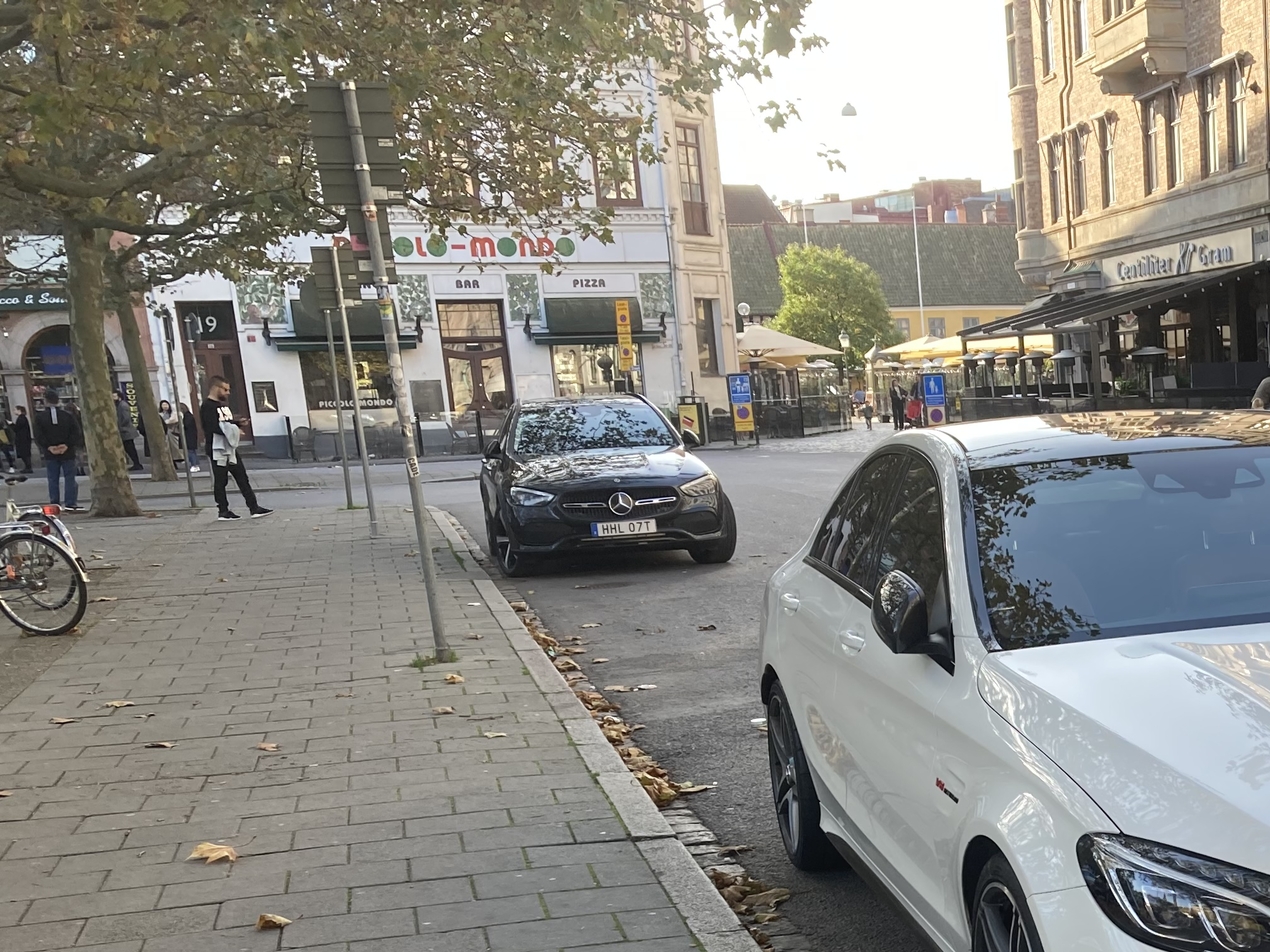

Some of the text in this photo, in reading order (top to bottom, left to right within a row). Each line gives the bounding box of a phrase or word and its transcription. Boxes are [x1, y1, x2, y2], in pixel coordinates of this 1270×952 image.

[1117, 243, 1234, 281] Centiliter Gram
[455, 279, 480, 289] BAR
[572, 278, 606, 288] PIZZA
[197, 315, 217, 333] 19
[357, 397, 393, 407] MONDO
[601, 523, 625, 535] HHL
[628, 521, 651, 533] 07T
